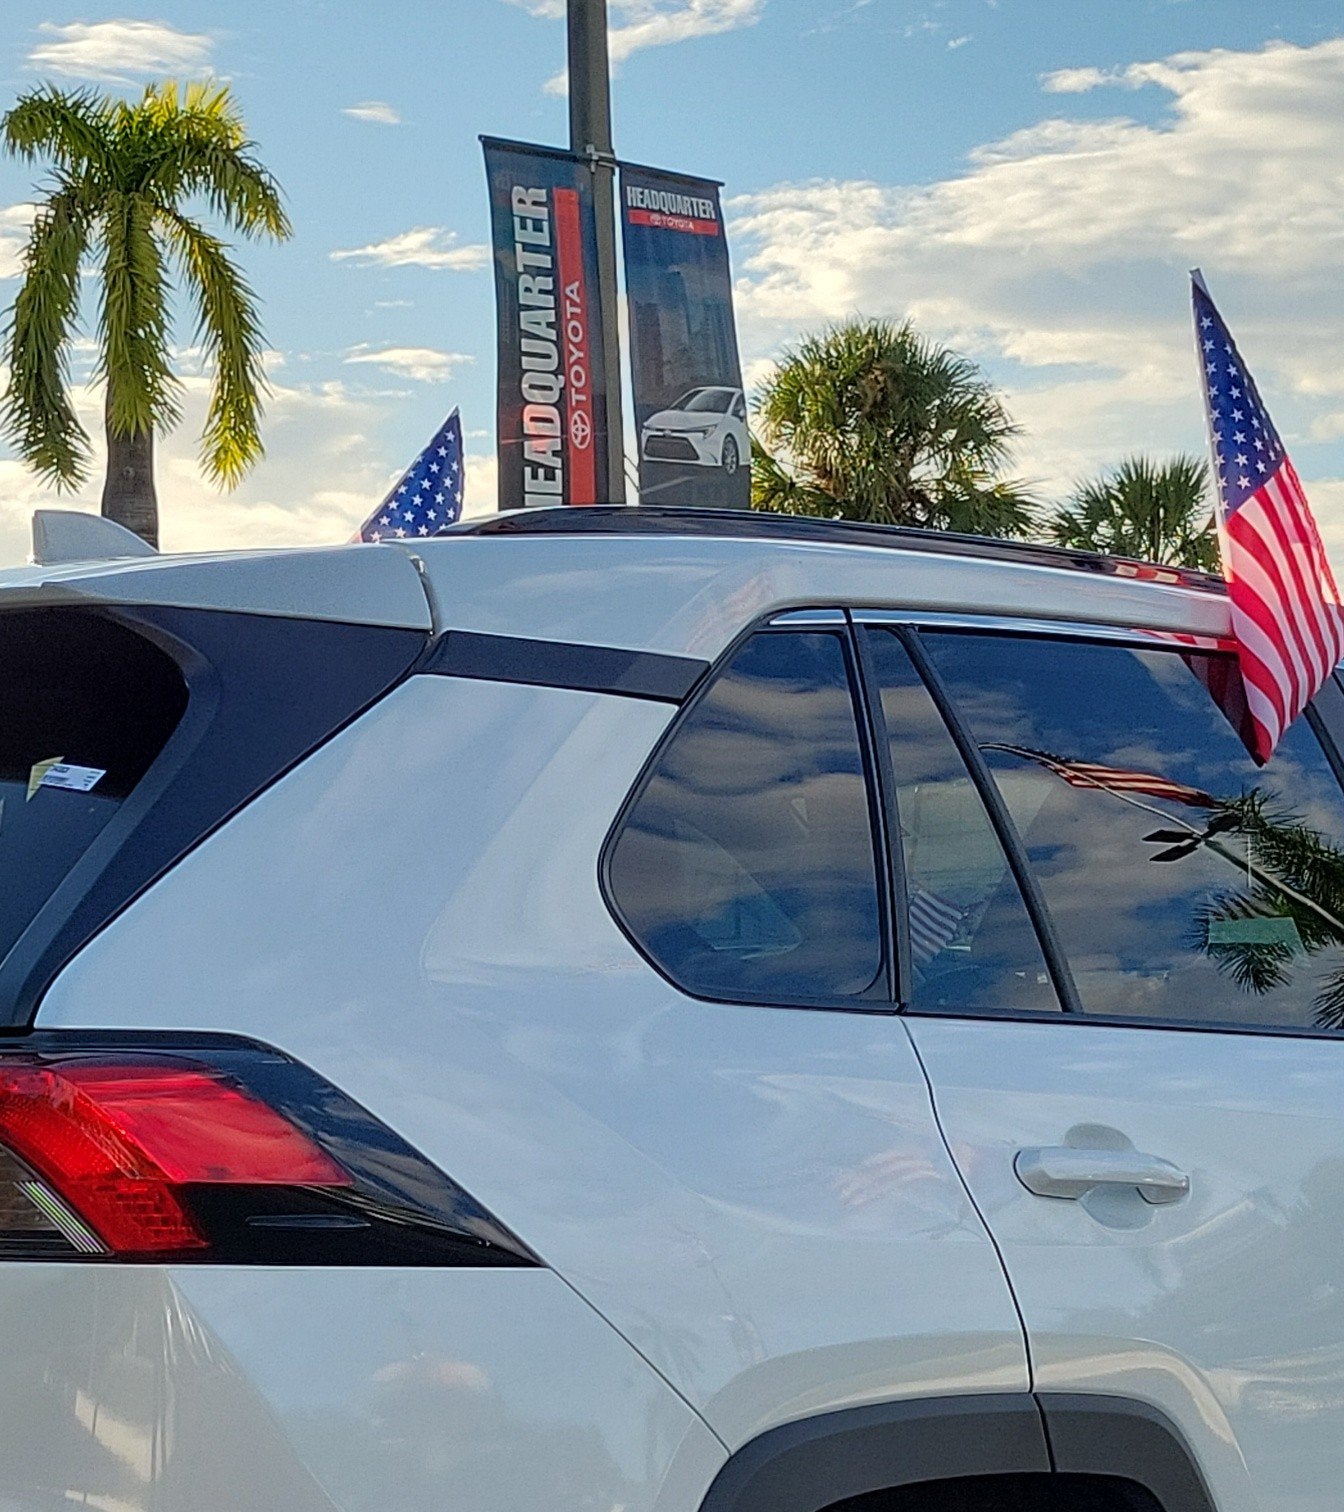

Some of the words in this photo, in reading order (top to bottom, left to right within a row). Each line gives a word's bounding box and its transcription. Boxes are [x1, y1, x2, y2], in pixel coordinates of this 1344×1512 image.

[626, 186, 716, 219] HEADQUARTER
[662, 215, 695, 231] TOYOTA
[564, 280, 587, 407] TOYOTA
